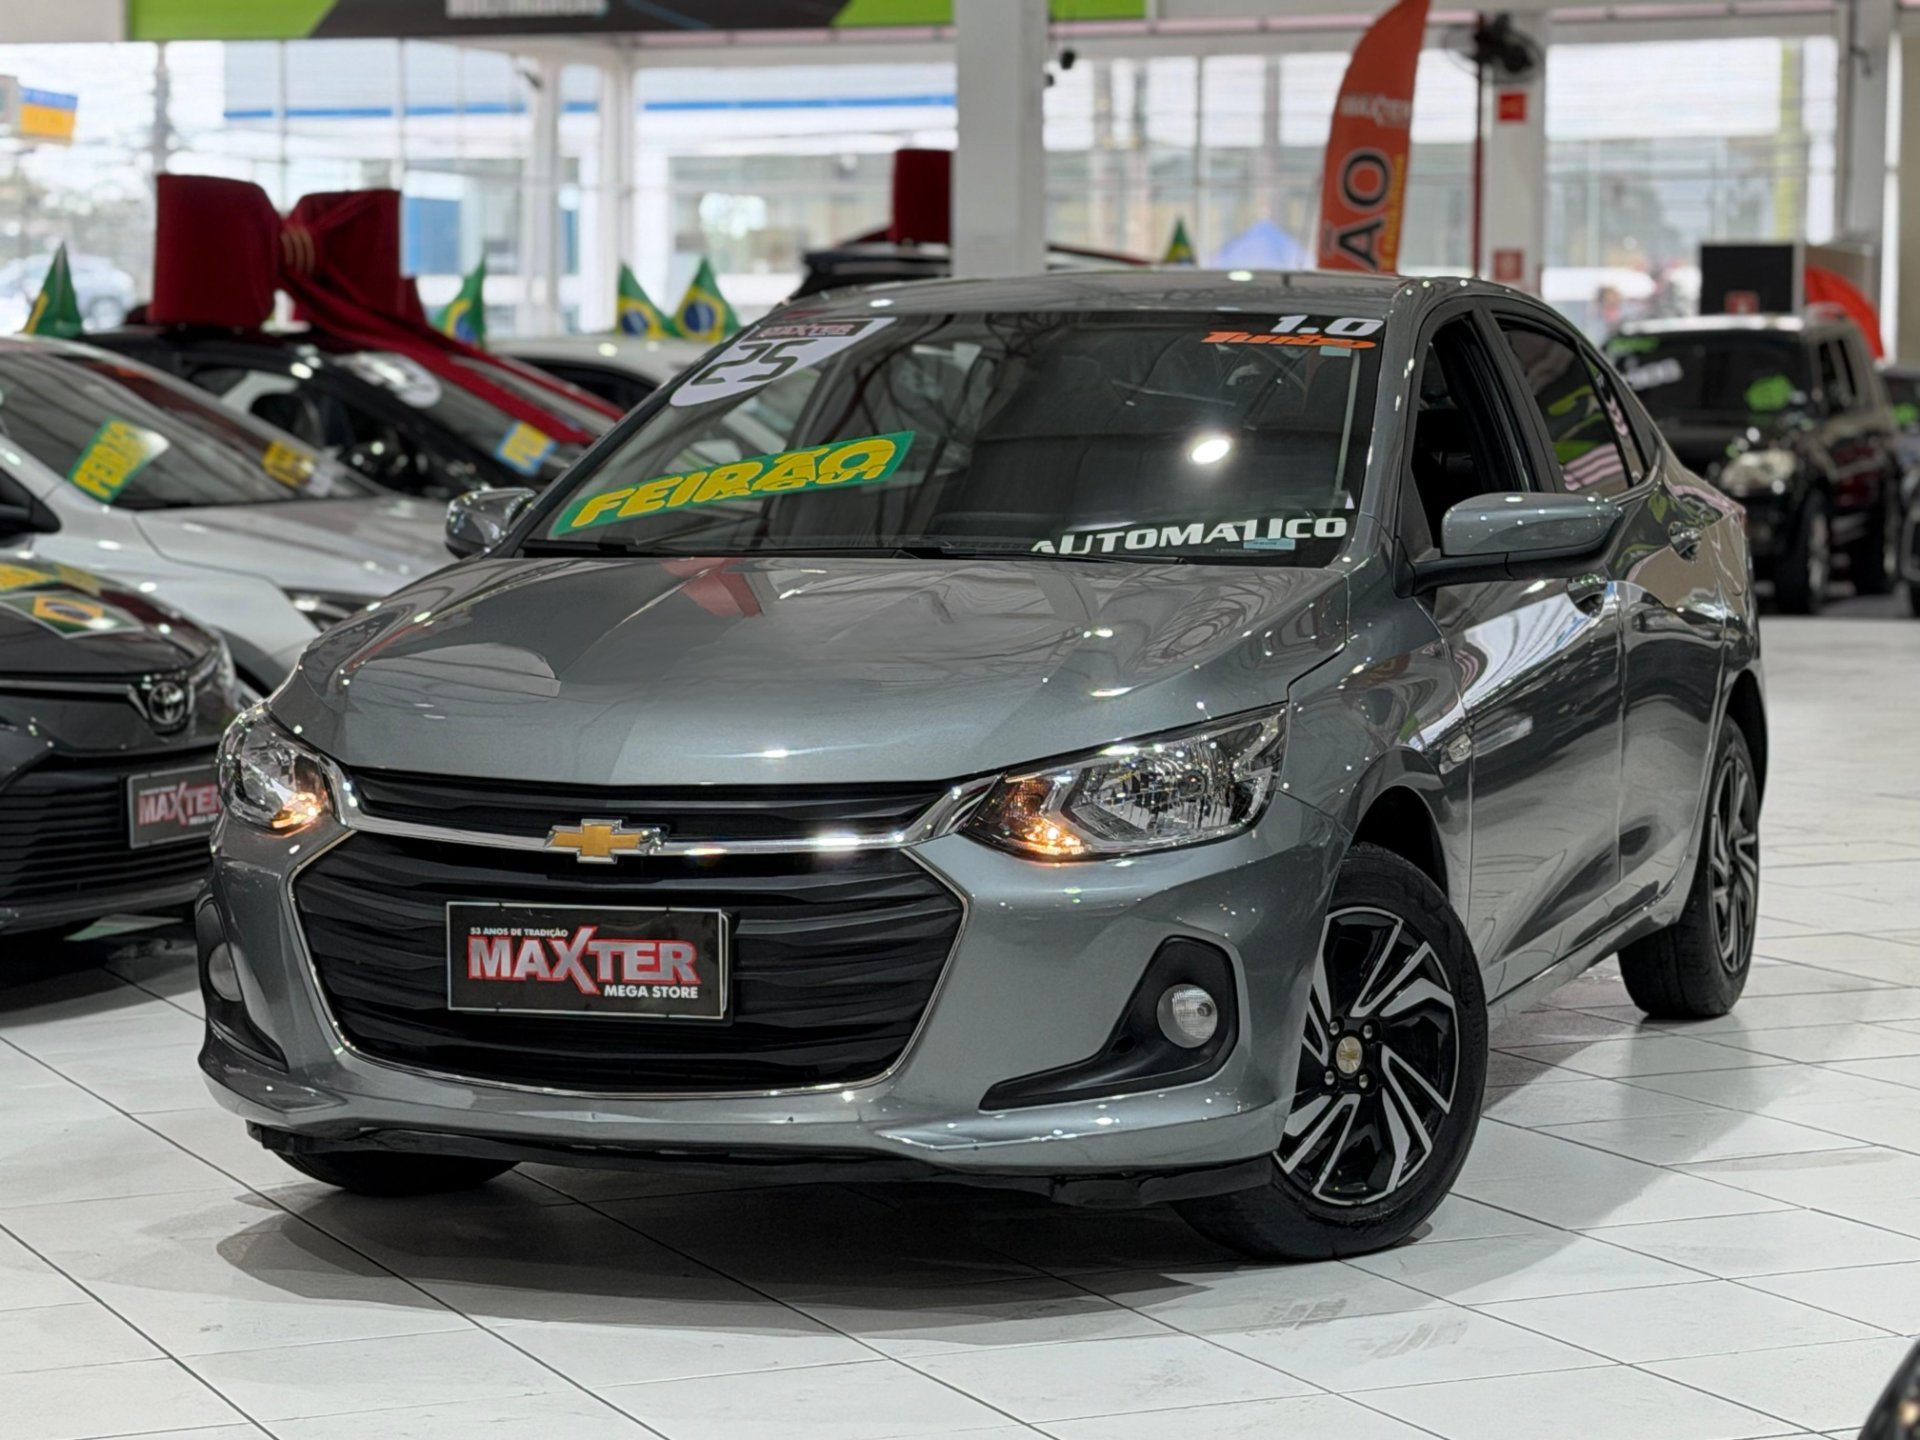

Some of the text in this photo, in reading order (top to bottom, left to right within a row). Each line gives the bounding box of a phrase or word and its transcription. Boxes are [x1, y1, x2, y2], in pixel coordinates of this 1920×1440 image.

[1270, 314, 1384, 337] 1.0
[689, 338, 820, 386] 25
[571, 439, 897, 528] FEIRÃO
[483, 927, 509, 937] ANOS
[511, 928, 522, 937] DE
[524, 927, 569, 939] TRADIÇÃO
[467, 925, 702, 995] MAXTER
[603, 984, 699, 999] MEGA STORE
